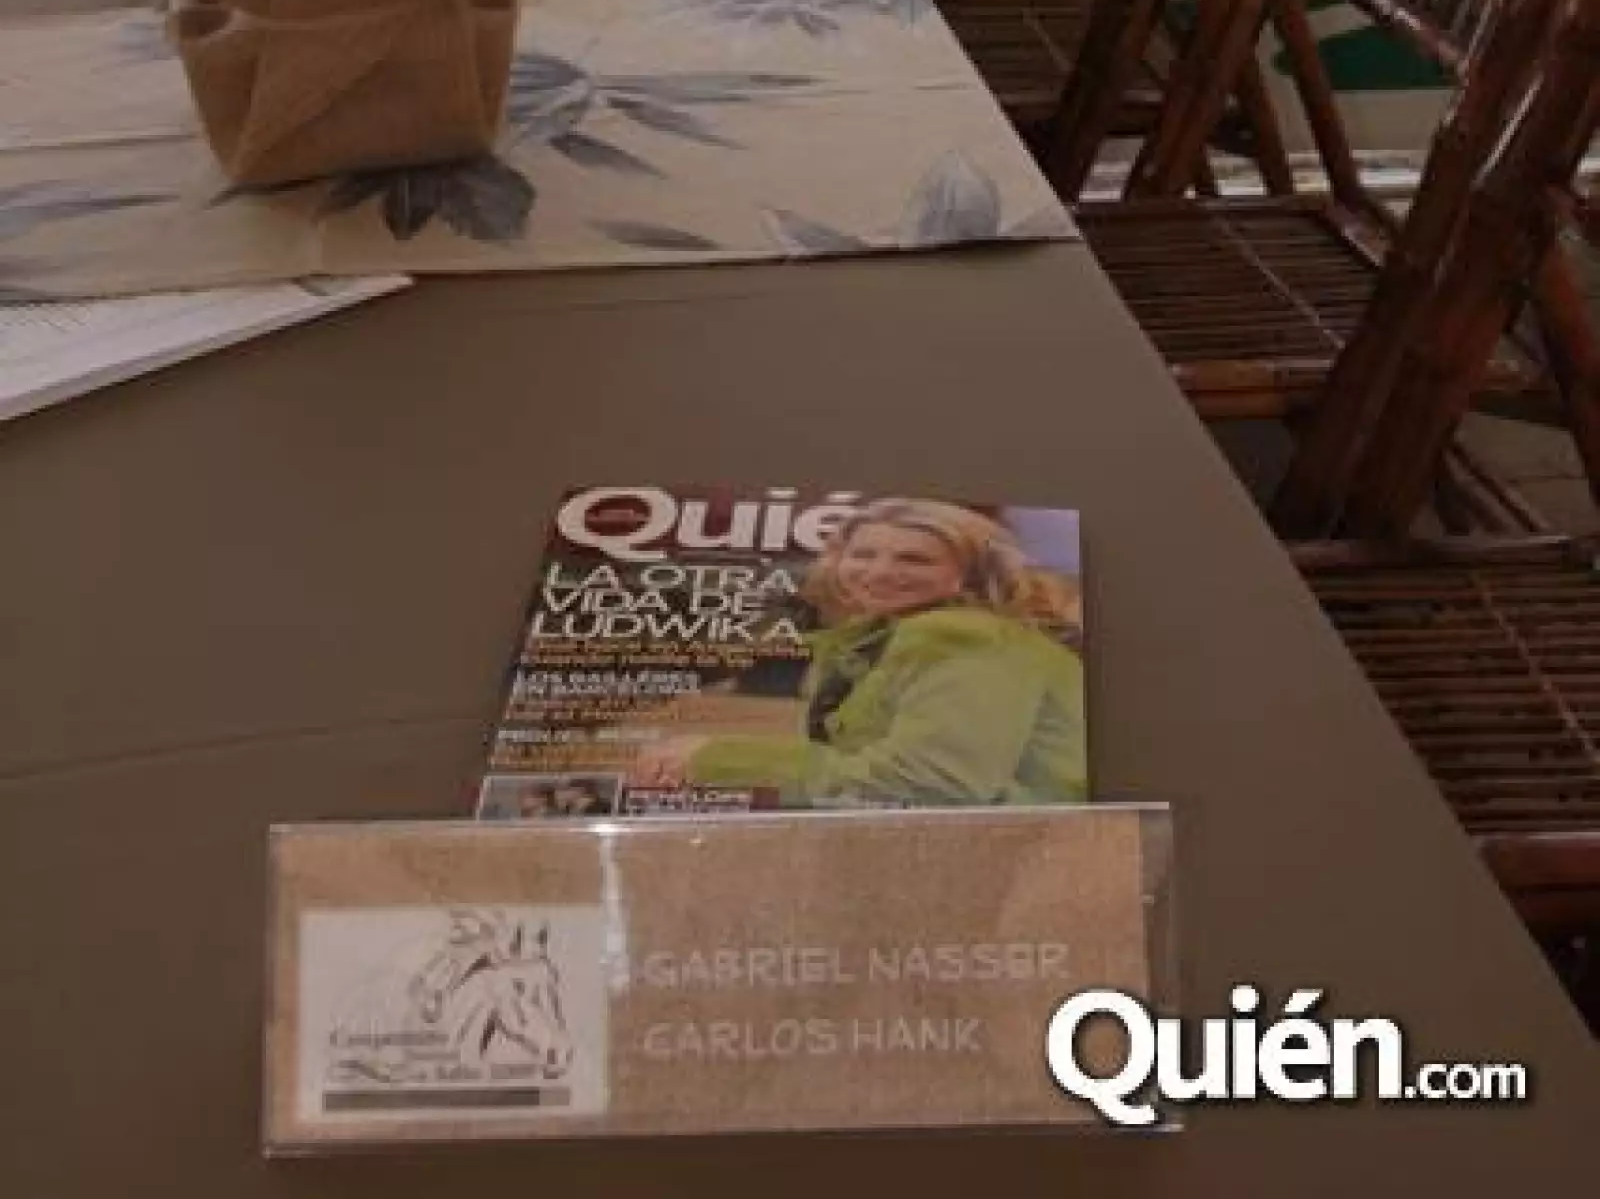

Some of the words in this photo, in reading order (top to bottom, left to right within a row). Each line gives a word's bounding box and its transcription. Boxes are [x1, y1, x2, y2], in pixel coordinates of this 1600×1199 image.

[557, 487, 862, 563] Quié
[547, 561, 621, 591] LA
[640, 565, 799, 594] OTRA
[545, 590, 669, 614] VIDA
[692, 589, 762, 616] DE
[531, 612, 802, 644] LUDWIKA
[643, 943, 856, 988] GABRIEL
[643, 1018, 838, 1058] CARLOS
[852, 1018, 982, 1053] HANK
